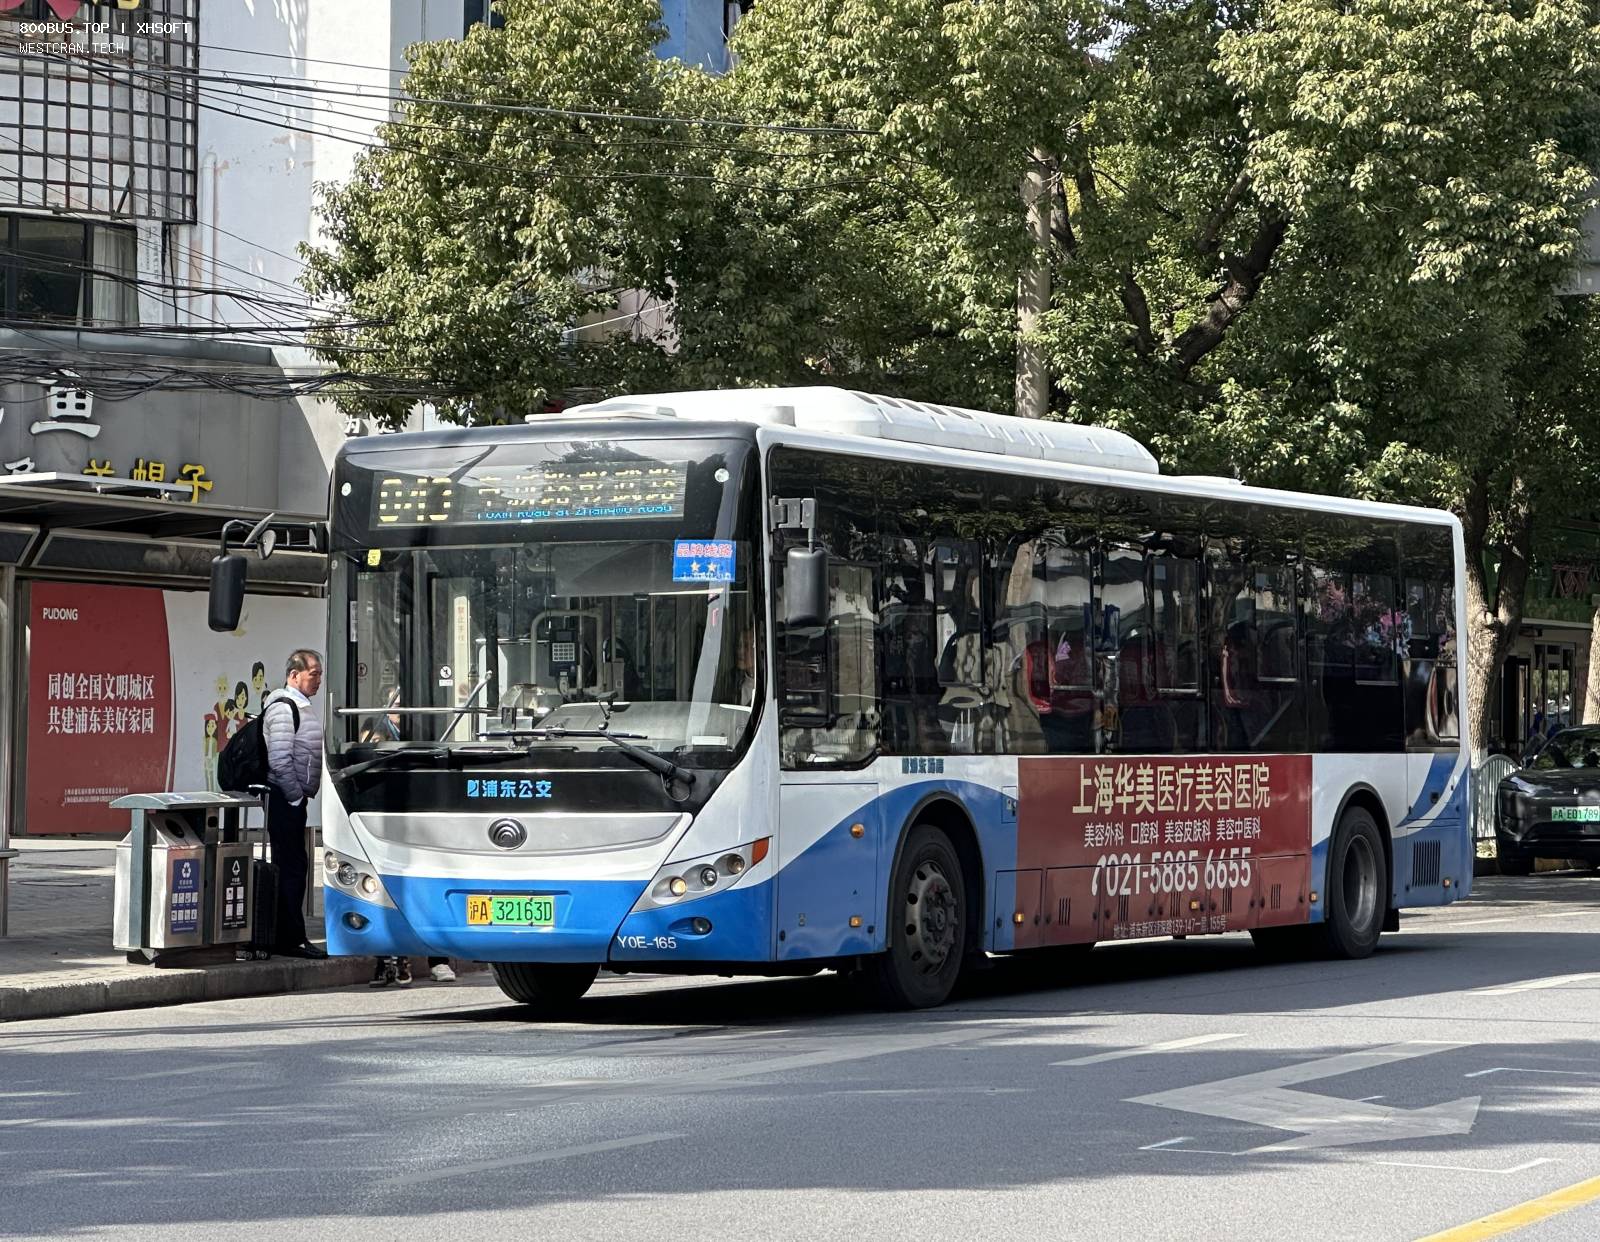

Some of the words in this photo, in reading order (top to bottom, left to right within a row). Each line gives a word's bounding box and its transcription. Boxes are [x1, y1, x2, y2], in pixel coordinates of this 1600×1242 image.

[43, 607, 79, 620] PUDONG
[48, 672, 155, 701] 同创全国文明城区
[47, 705, 155, 734] 共建浦东美好家园
[482, 779, 552, 798] 浦东公交
[1072, 762, 1271, 815] 上海华美医疗美容医院
[1084, 821, 1125, 848] 美容外科
[1130, 820, 1160, 845] 口腔科
[1164, 818, 1212, 844] 美容皮肤科
[1216, 816, 1261, 841] 美容中医科
[1105, 850, 1199, 897] 021-5885
[1204, 847, 1252, 890] 6655
